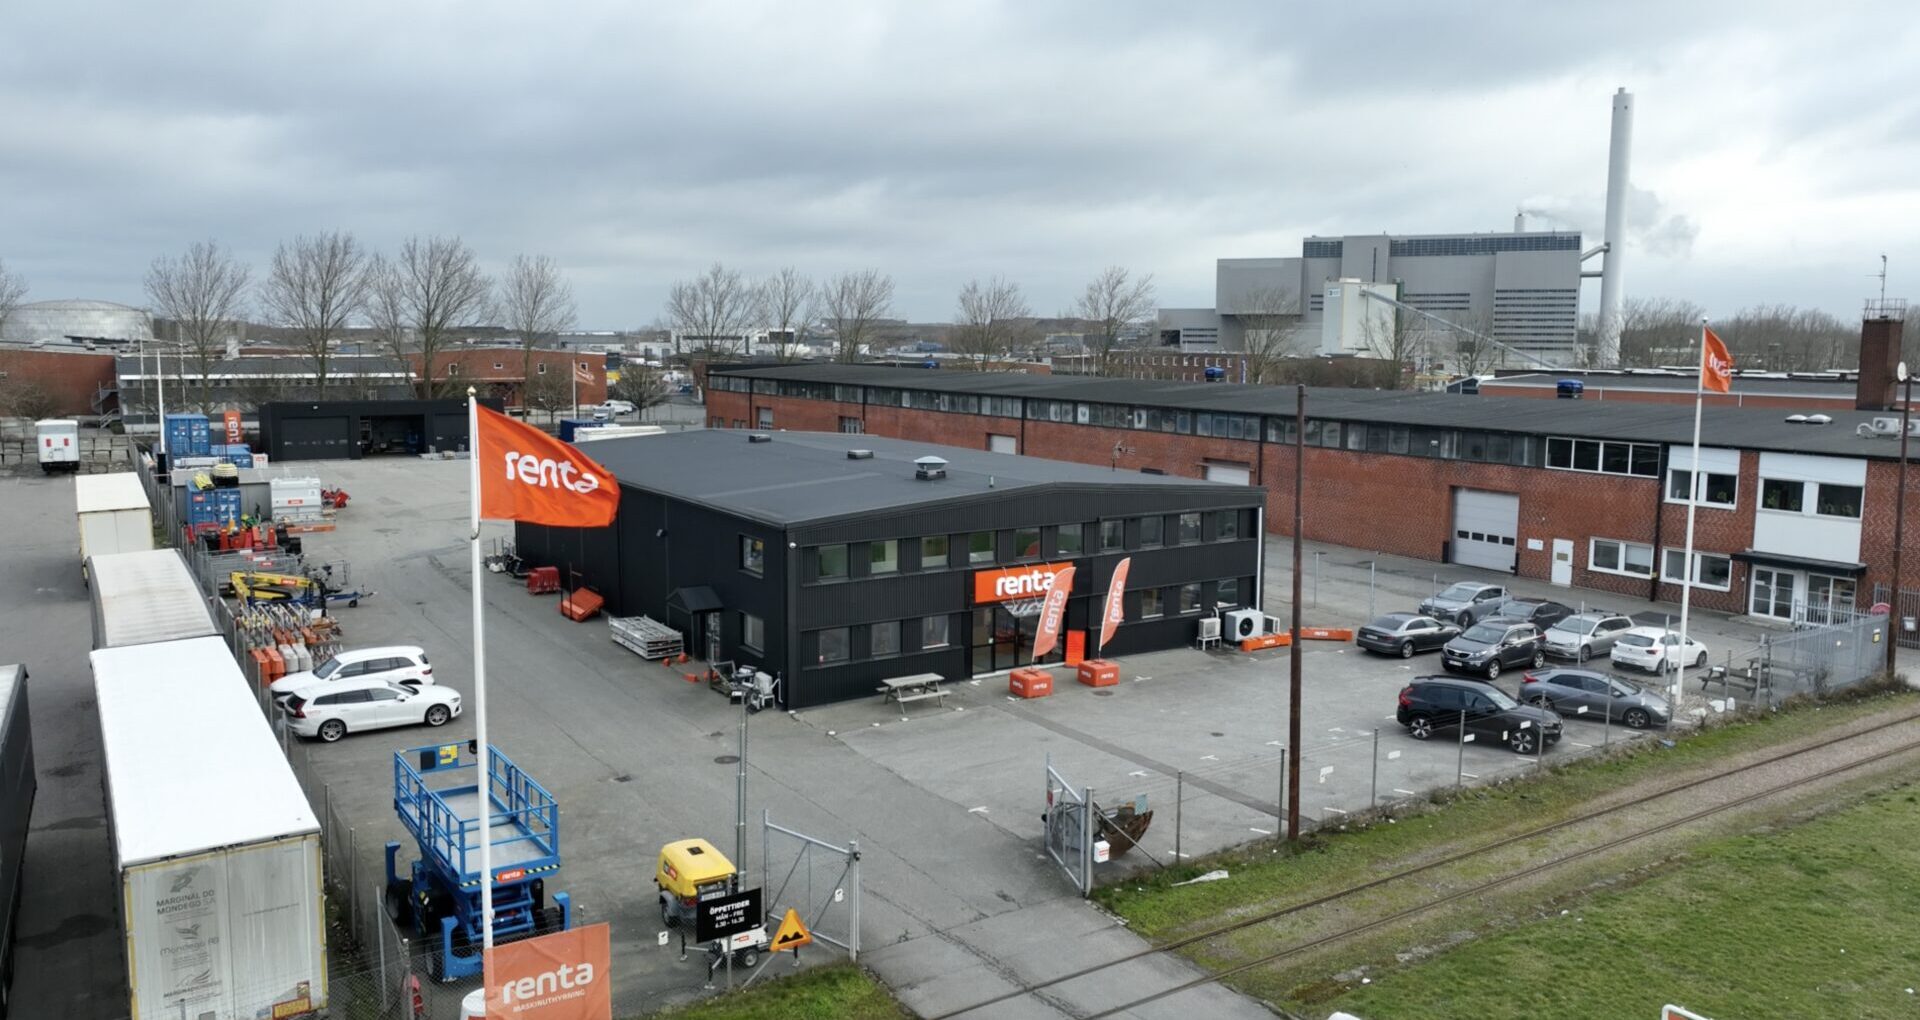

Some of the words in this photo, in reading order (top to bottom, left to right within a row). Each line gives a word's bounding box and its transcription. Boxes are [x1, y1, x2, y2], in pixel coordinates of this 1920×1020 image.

[228, 417, 239, 443] rent
[505, 451, 599, 493] renta
[996, 569, 1055, 597] renta
[1044, 589, 1064, 634] renta
[1110, 580, 1123, 623] renta
[502, 870, 521, 880] renta
[157, 893, 200, 907] MARGINAL
[203, 889, 214, 898] DO
[158, 901, 201, 914] MONDEGO
[709, 900, 750, 915] ÖPPETTIDER
[716, 913, 728, 921] MÅN
[503, 962, 593, 1004] renta
[513, 990, 586, 1013] MASKINUTHYRNING
